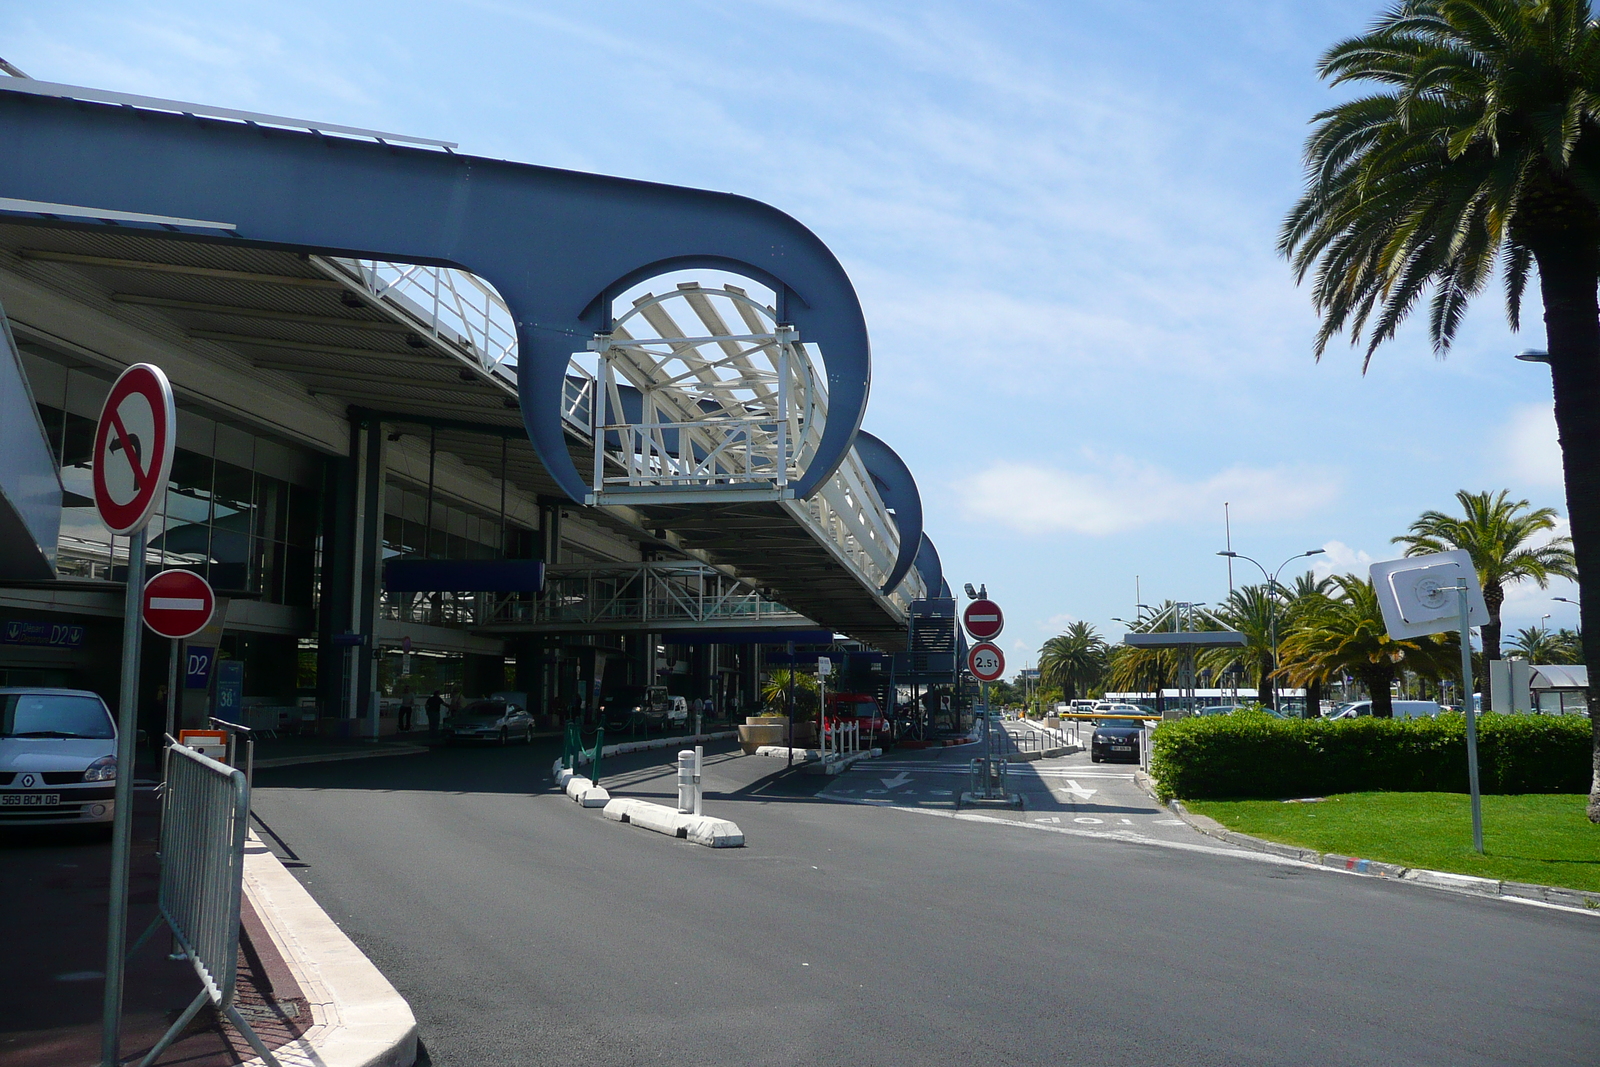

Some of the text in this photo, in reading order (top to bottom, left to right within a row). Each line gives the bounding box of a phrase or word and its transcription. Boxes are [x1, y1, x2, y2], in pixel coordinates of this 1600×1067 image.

[49, 625, 69, 645] D2
[187, 655, 208, 676] D2
[2, 795, 59, 805] 569 BCM 06
